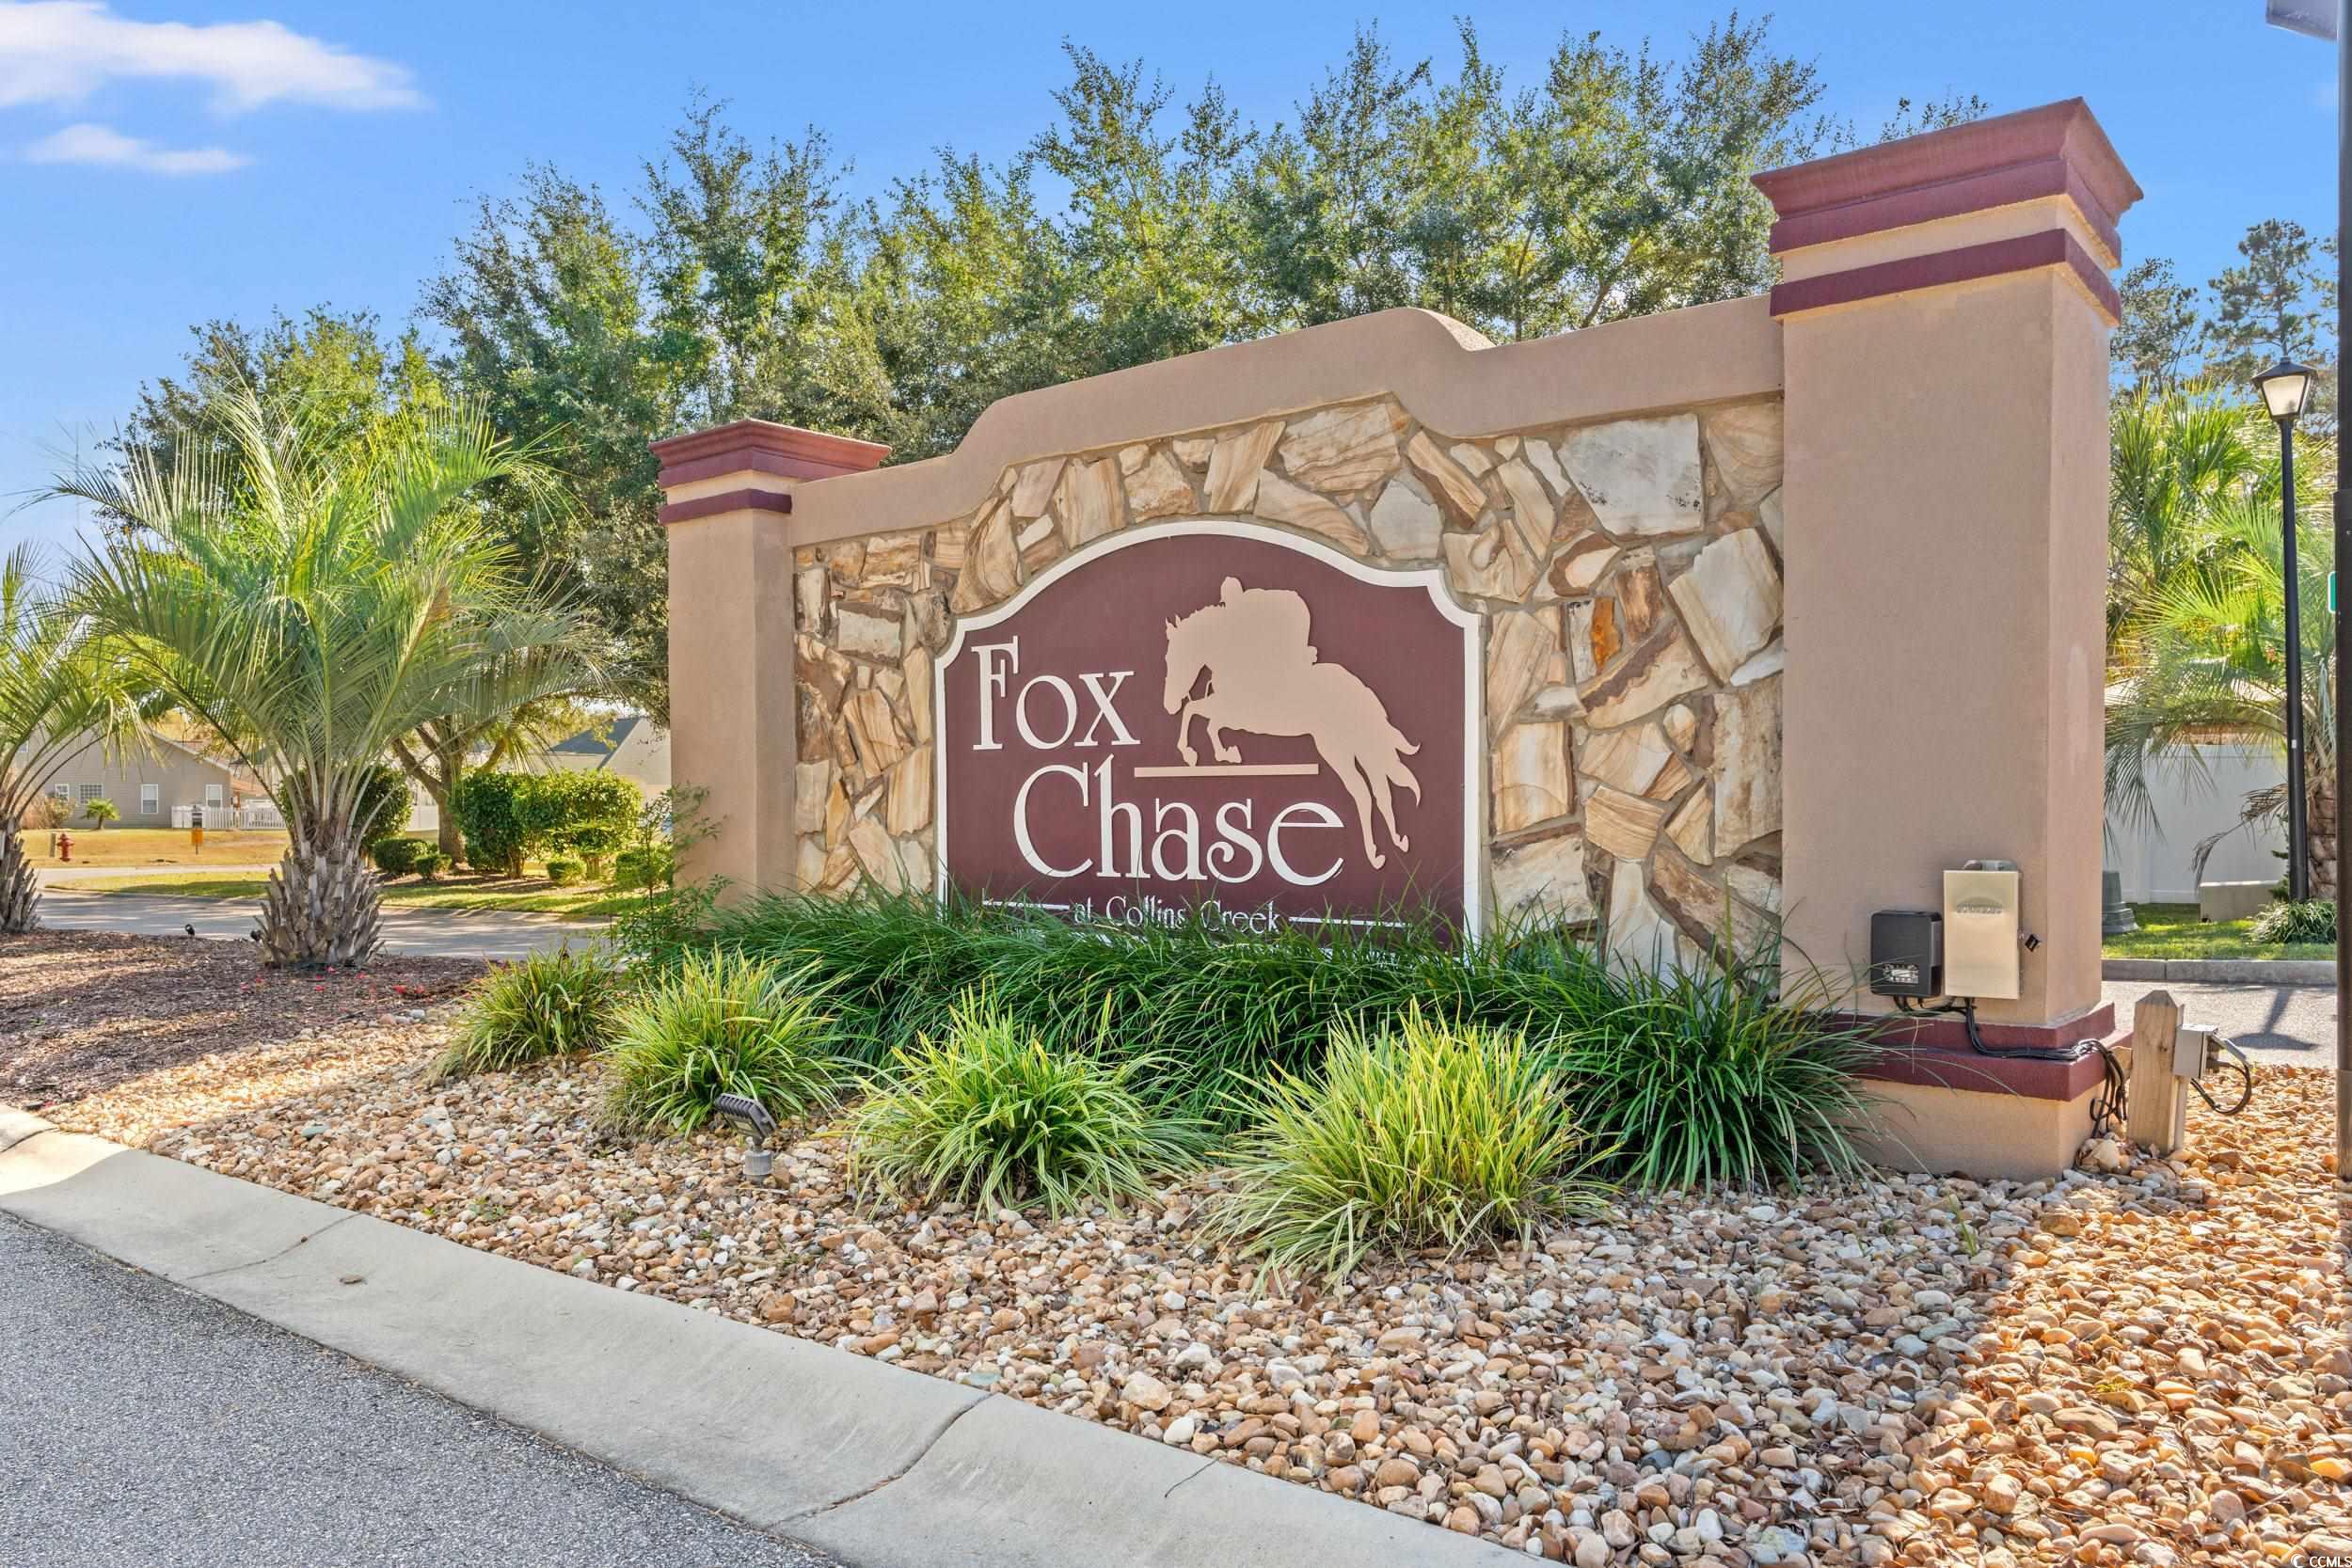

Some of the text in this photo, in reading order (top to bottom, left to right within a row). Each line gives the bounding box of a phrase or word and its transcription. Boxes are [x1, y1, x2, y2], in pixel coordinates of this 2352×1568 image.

[971, 635, 1141, 751] Fox
[1013, 753, 1344, 886] Chase
[1074, 895, 1280, 935] at Collins Creek
